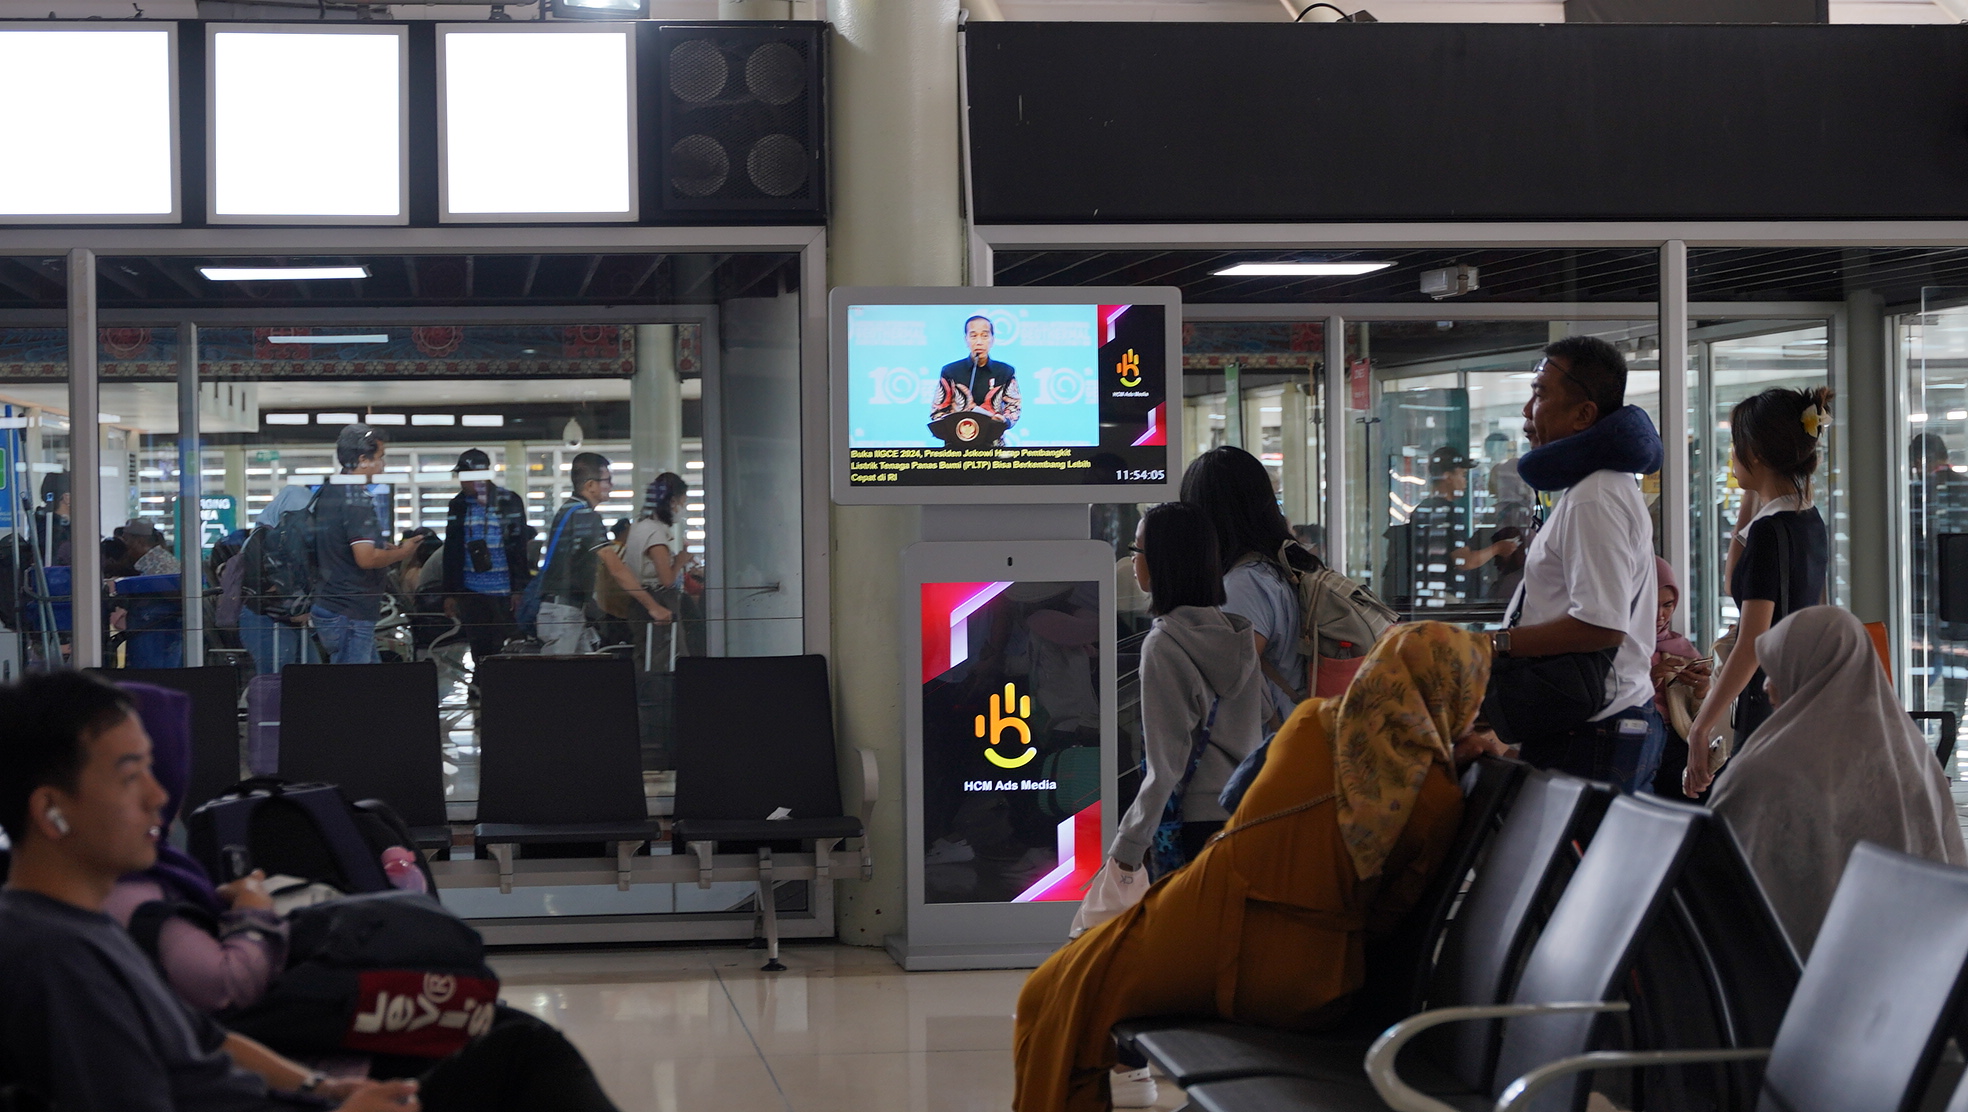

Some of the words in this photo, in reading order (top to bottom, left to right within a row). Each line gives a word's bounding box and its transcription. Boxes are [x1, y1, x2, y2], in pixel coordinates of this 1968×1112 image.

[850, 450, 873, 459] Buka
[900, 450, 923, 459] 2024,
[924, 450, 962, 458] Presiden
[963, 450, 993, 458] Jokowi
[994, 449, 1020, 459] Harap
[1021, 448, 1072, 459] Pembangkit
[850, 461, 878, 470] Listrik
[879, 461, 910, 472] Tenaga
[911, 461, 938, 470] Panas
[939, 461, 962, 470] Bumi
[962, 461, 991, 471] (PLTP)
[992, 461, 1012, 470] Bisa
[1013, 460, 1066, 471] Berkembang
[1067, 460, 1092, 469] Lebih
[850, 473, 876, 484] Cepat
[877, 473, 886, 482] di
[887, 473, 898, 482] RI
[1116, 469, 1165, 481] 11:54:05
[963, 780, 993, 792] HCM
[994, 780, 1019, 791] Ads
[1020, 779, 1057, 791] Media
